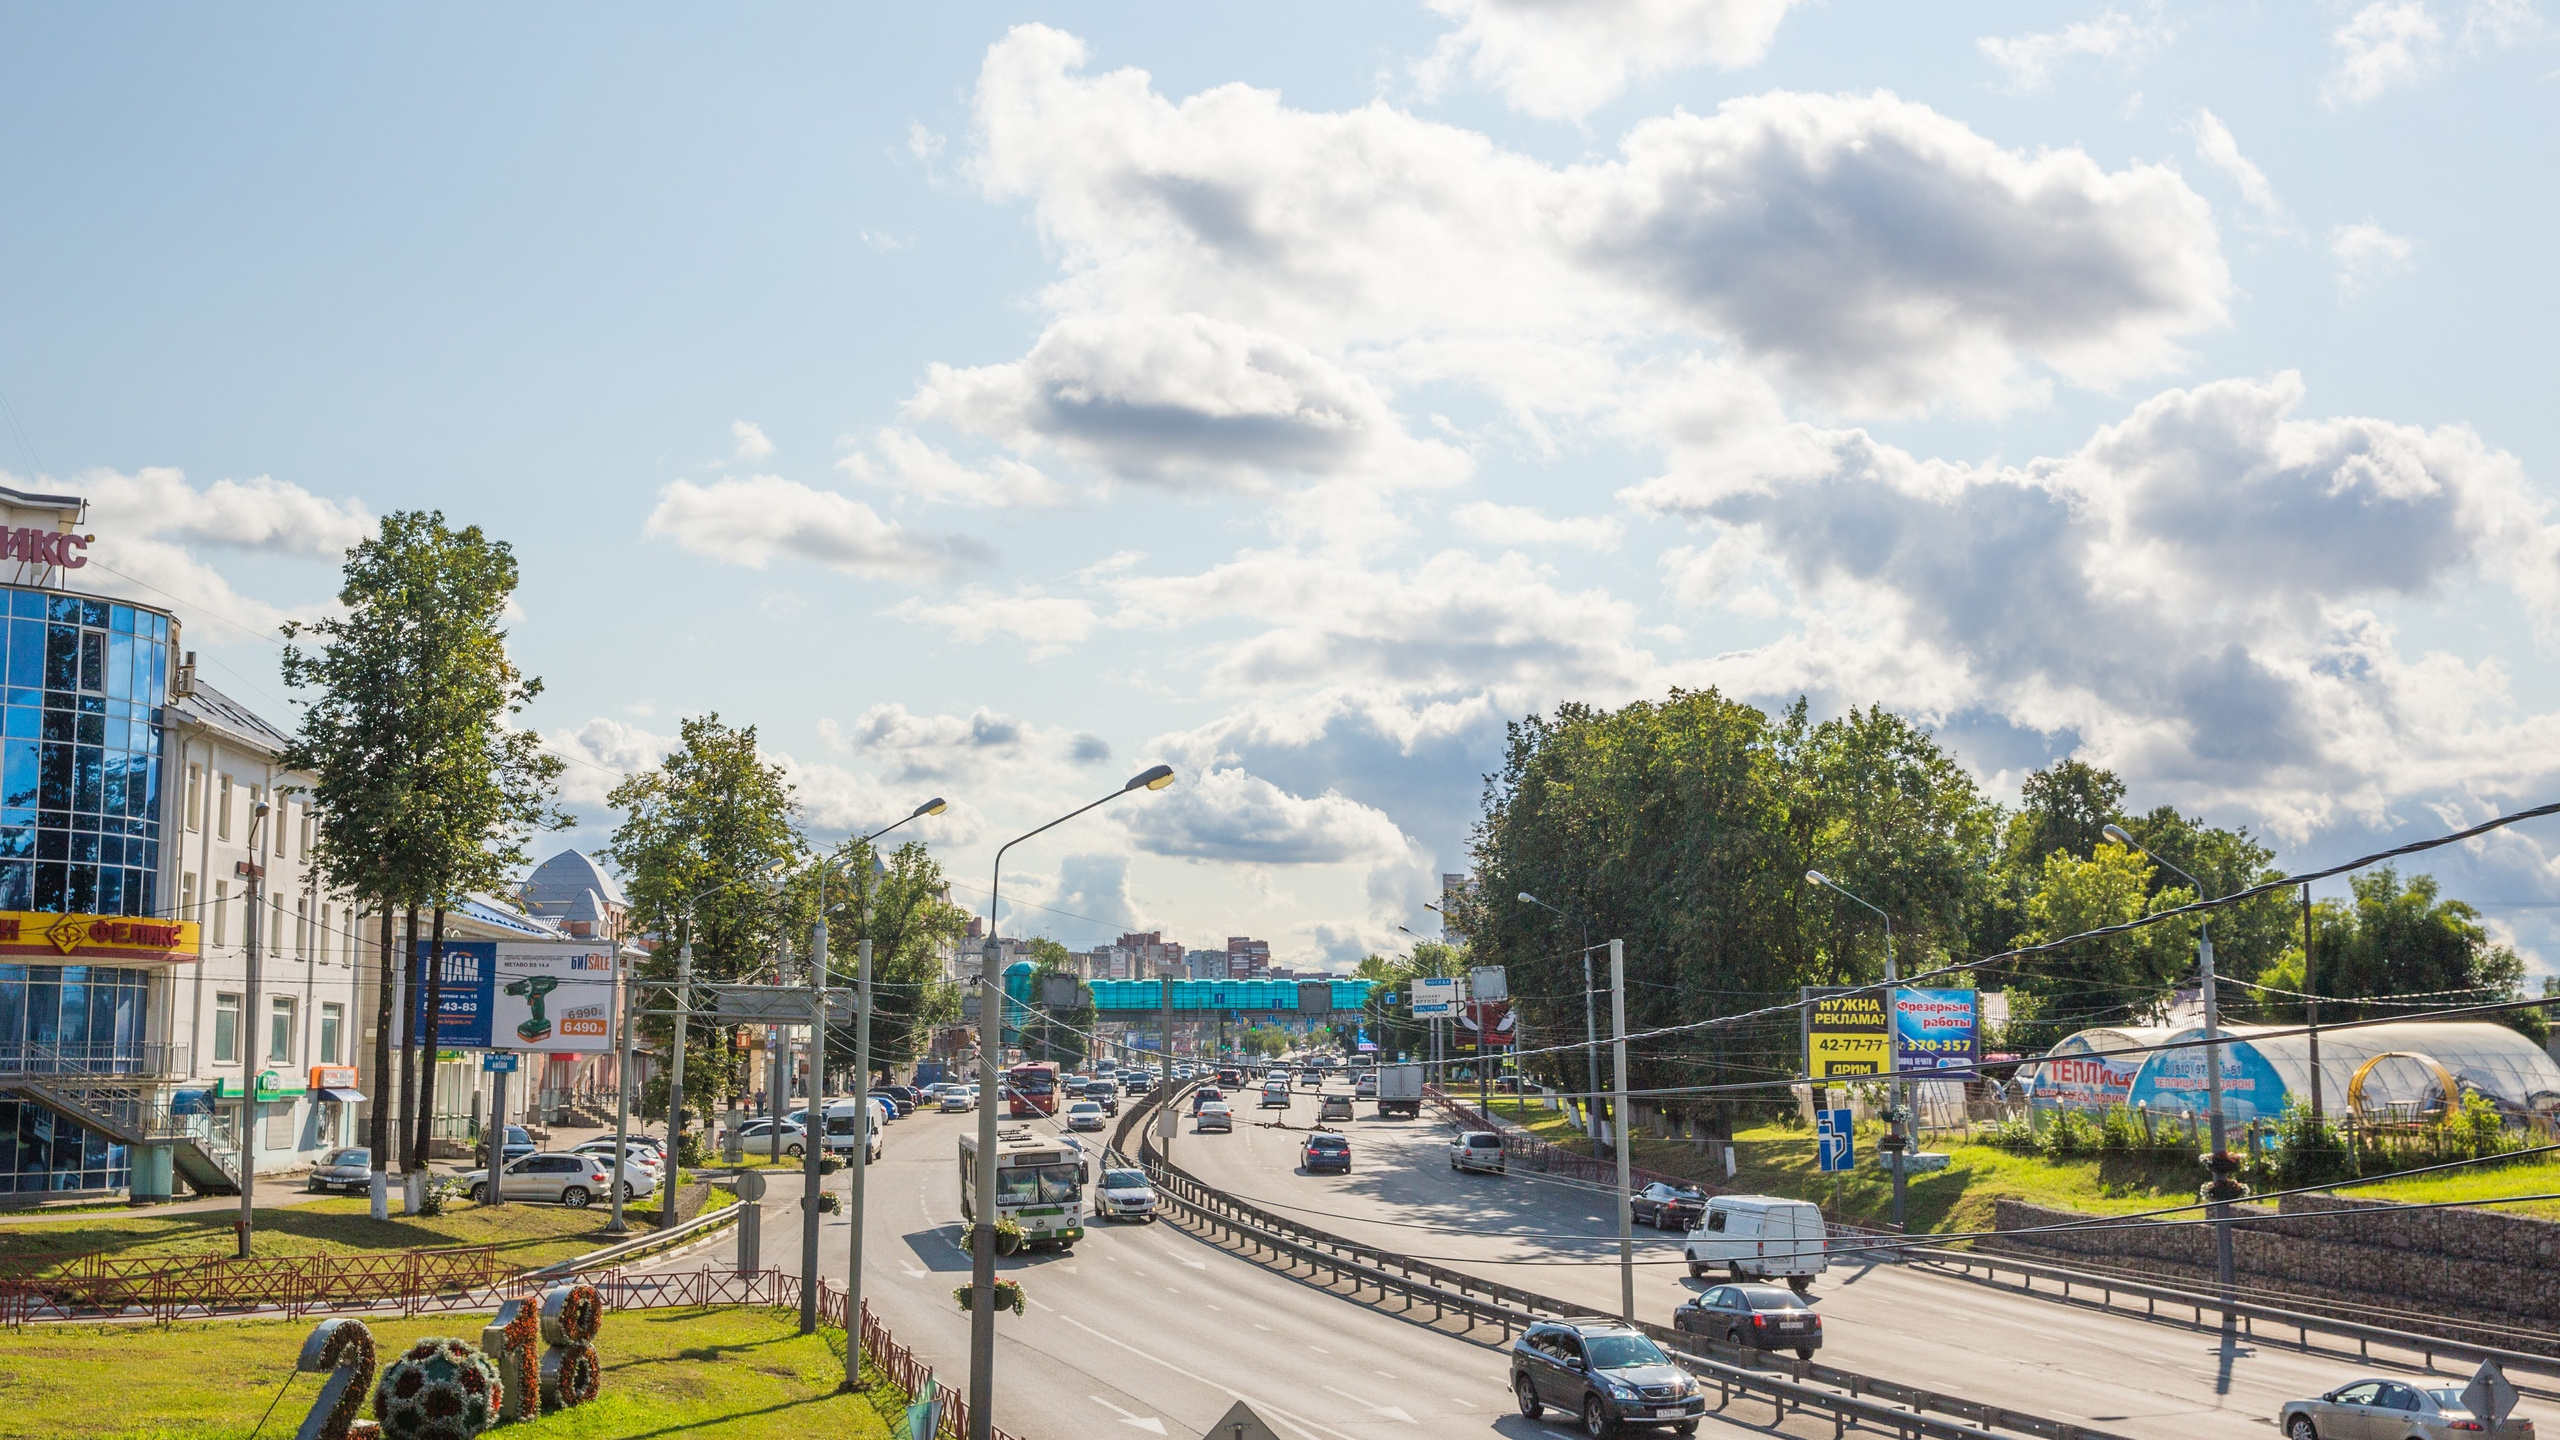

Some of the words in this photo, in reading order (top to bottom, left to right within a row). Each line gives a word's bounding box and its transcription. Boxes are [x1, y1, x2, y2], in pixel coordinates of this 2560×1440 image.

[88, 920, 183, 947] ФЕЛИКС
[424, 1001, 478, 1011] 5-43-83
[1819, 999, 1881, 1012] НУЖНА
[1897, 1001, 1970, 1014] Фрезерные
[1815, 1013, 1887, 1025] РЕКЛАМА?
[1923, 1016, 1971, 1029] работы
[1819, 1039, 1883, 1052] 42-77-77
[1908, 1039, 1971, 1052] 370-357
[1831, 1064, 1872, 1075] ДРИМ
[2154, 1078, 2195, 1089] ТЕПЛИЦА
[2205, 1079, 2255, 1090] ПДАРОК!
